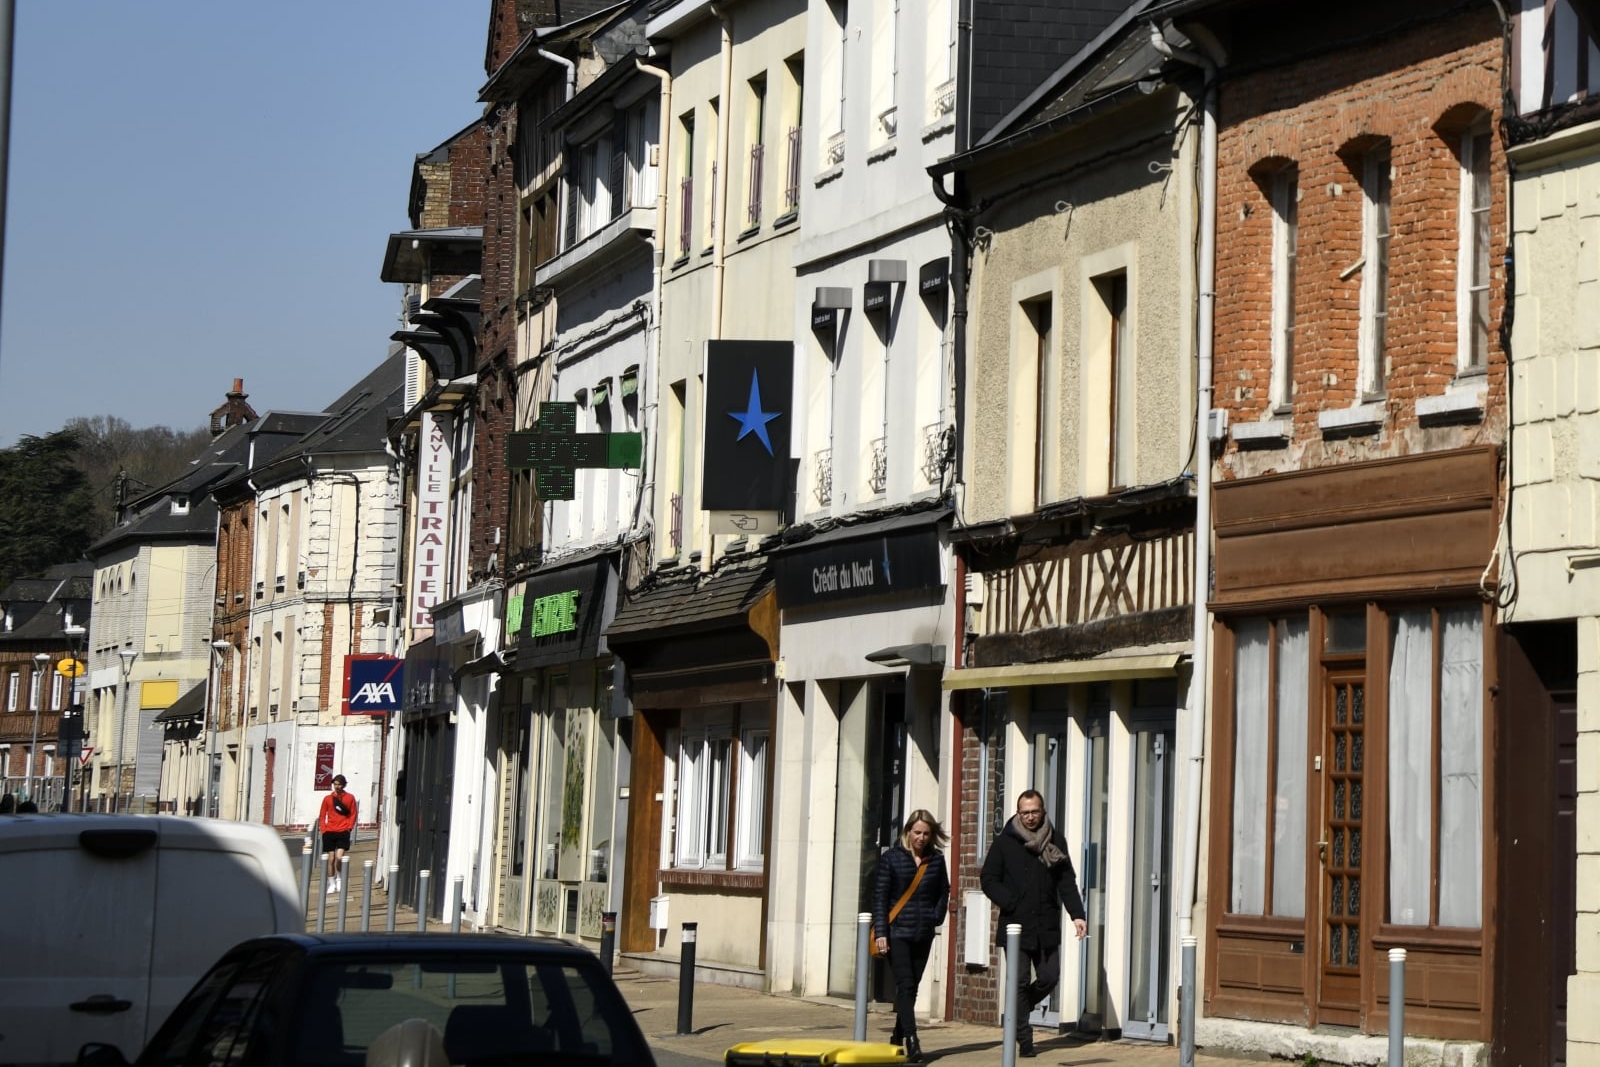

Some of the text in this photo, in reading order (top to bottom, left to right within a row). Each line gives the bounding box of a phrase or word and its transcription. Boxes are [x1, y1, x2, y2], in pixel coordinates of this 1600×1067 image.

[416, 414, 446, 625] CANVILLE TRAITEUR
[812, 558, 874, 594] Crédit du Nord
[350, 682, 397, 704] AXA
